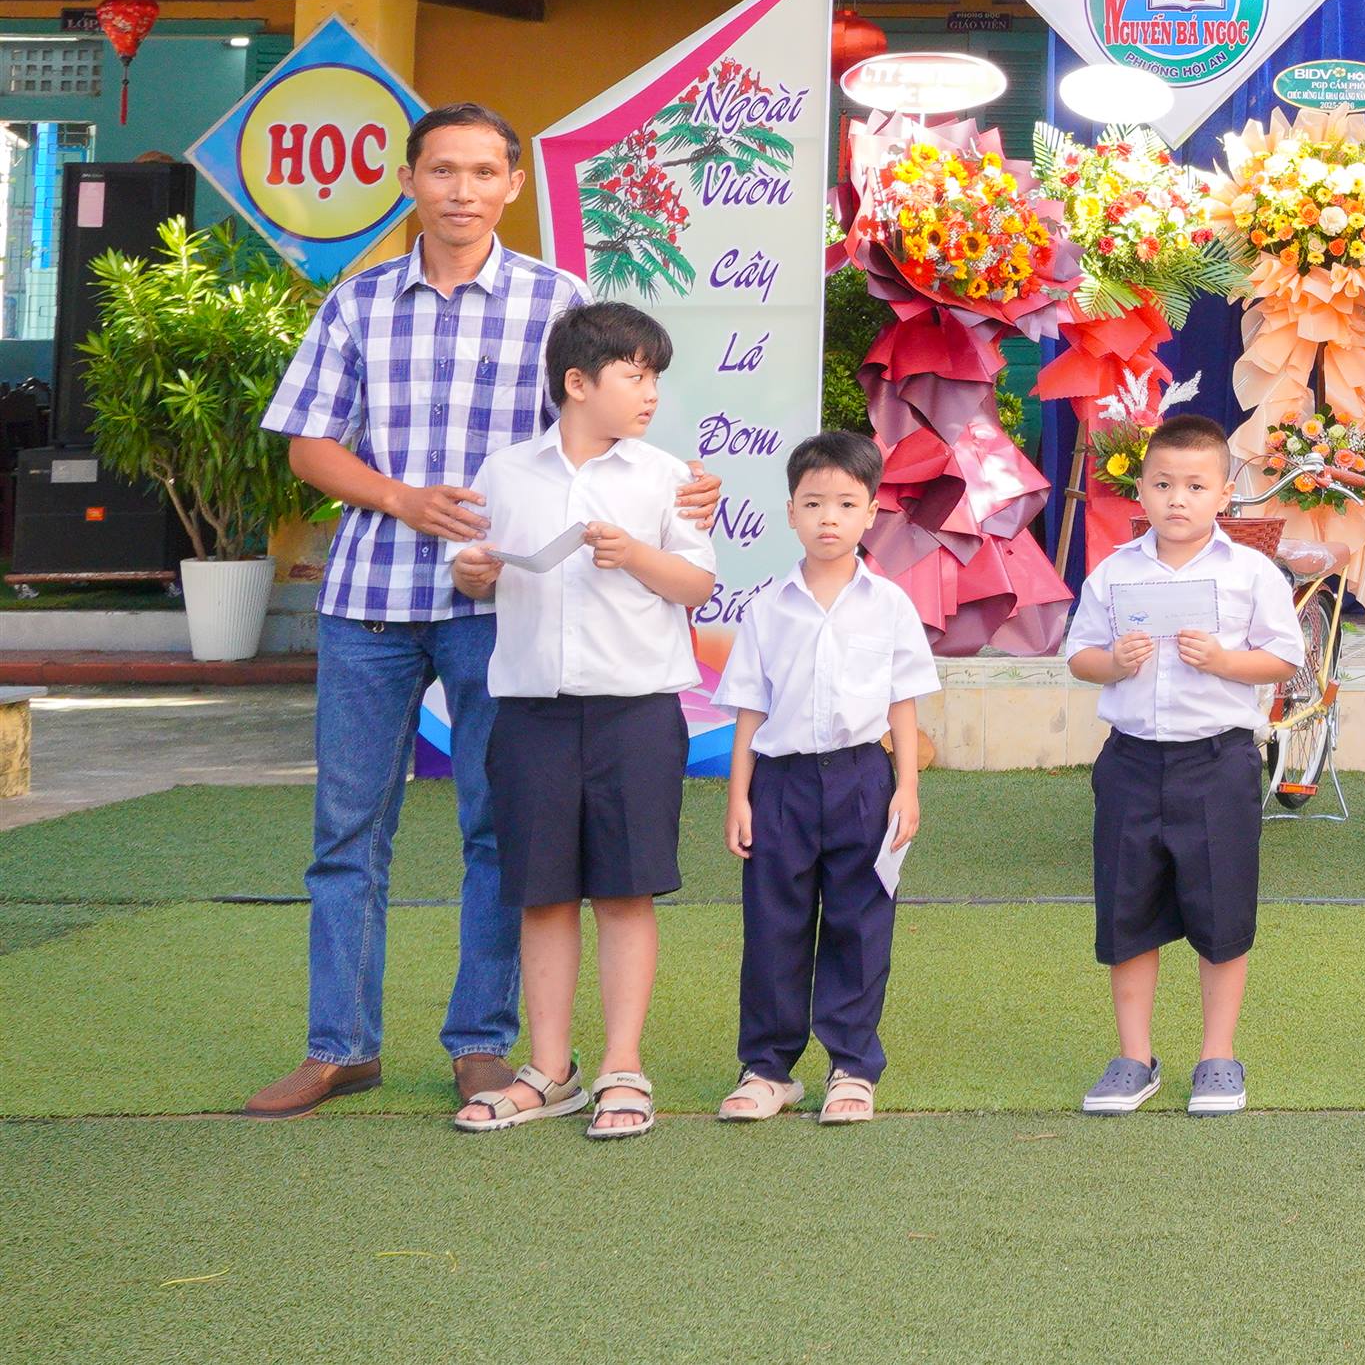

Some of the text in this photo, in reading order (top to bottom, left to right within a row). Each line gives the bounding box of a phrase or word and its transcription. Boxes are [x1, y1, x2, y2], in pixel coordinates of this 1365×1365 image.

[1176, 14, 1199, 45] BÁ
[1203, 20, 1249, 50] NGỌC
[1124, 52, 1228, 78] PHƯỜNG HỘI AN
[1294, 68, 1333, 80] BIDV
[694, 81, 810, 134] Ngoài
[266, 123, 387, 200] HỌC
[702, 164, 793, 207] Vườn
[709, 248, 779, 304] Cây
[718, 332, 770, 372] Lá
[698, 411, 783, 459] Đơm
[708, 497, 765, 548] Nụ
[695, 576, 773, 624] Biế
